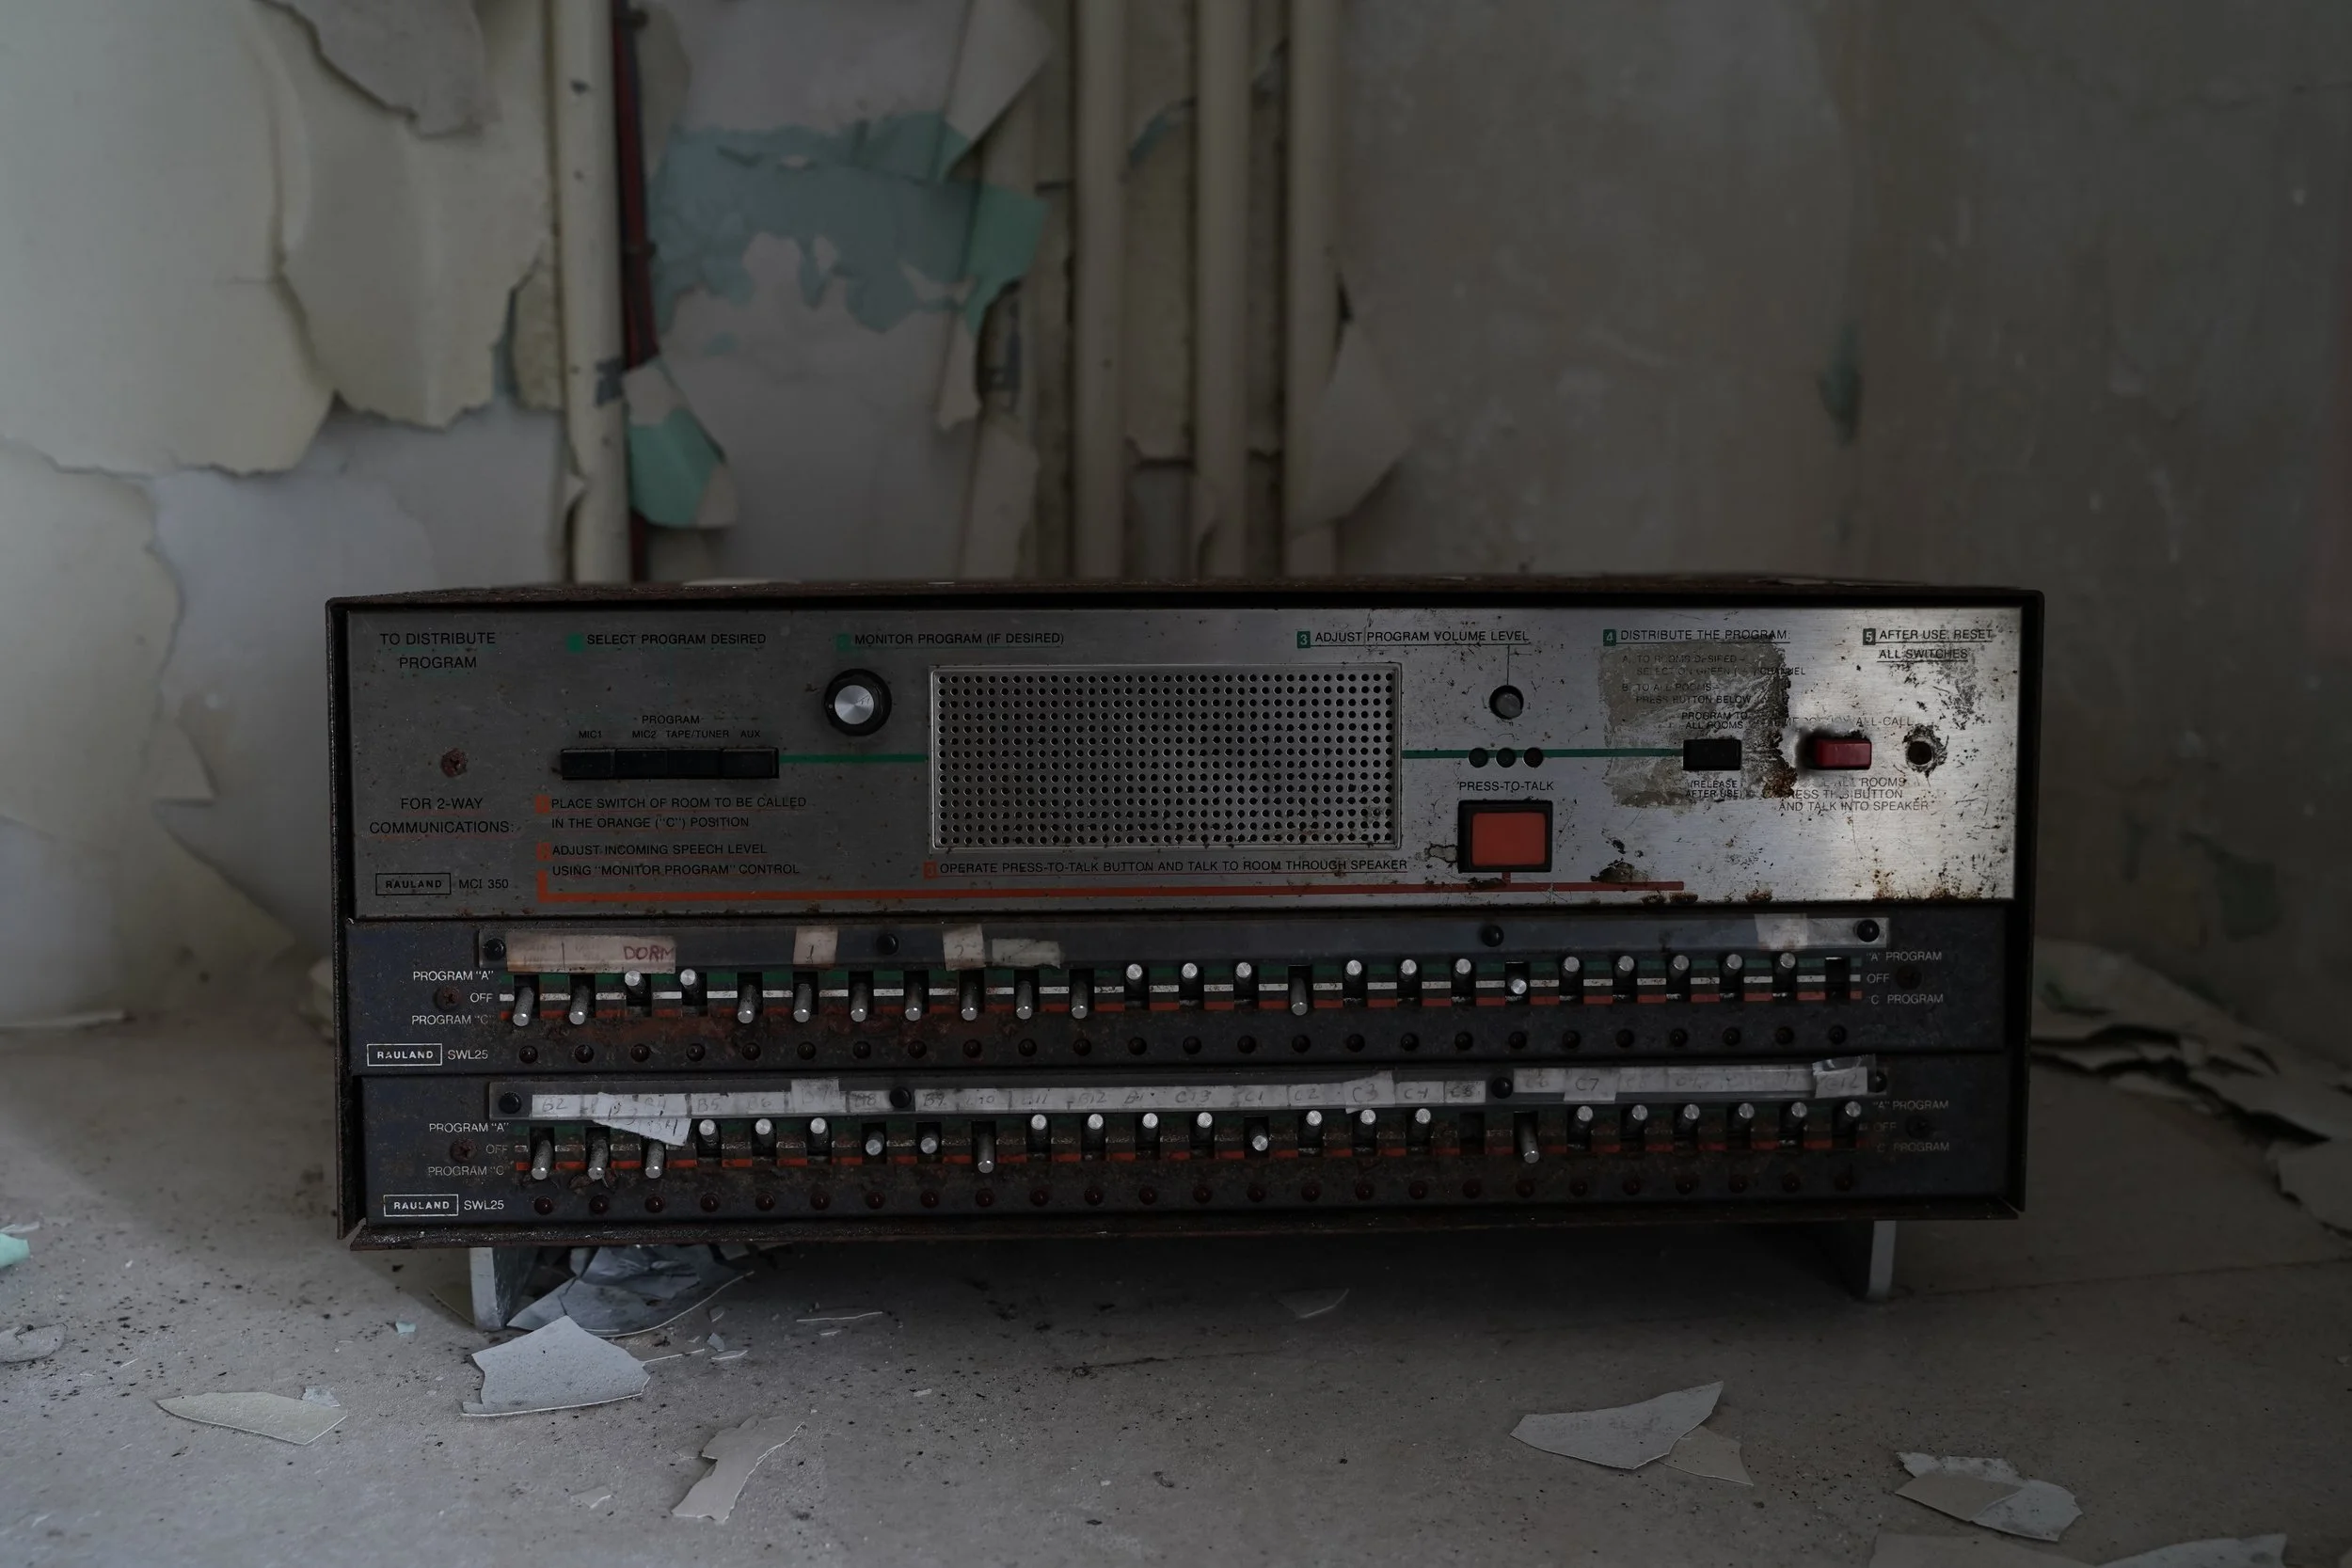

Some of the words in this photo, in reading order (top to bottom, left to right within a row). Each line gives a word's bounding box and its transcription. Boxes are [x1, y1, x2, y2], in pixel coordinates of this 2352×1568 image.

[380, 632, 400, 645] TO
[406, 631, 496, 645] DISTRIBUTE
[587, 634, 636, 645] SELECT
[642, 633, 706, 645] PROGRAM
[711, 633, 767, 644] DESIRED
[854, 633, 914, 645] MONITOR
[917, 633, 982, 644] PROGRAM
[986, 631, 1002, 646] (IF
[1006, 631, 1064, 645] DESIRED)
[1315, 631, 1362, 642] ADJUST
[1367, 631, 1430, 642] PROGRAM
[1434, 631, 1486, 641] VOLUME
[1491, 630, 1530, 641] LEVEL
[1620, 629, 1692, 641] DISTRIBUTE
[1697, 629, 1720, 641] THE
[1879, 629, 1918, 640] AFTER
[1953, 628, 1993, 640] RESET
[1879, 649, 1901, 659] ALL
[1905, 648, 1968, 658] SWITCHES
[399, 657, 477, 669] PROGRAM
[1716, 695, 1752, 705] BELOW
[642, 715, 700, 725] PROGRAM
[1681, 711, 1731, 721] PROGRAM
[1735, 711, 1748, 721] TO
[1685, 721, 1704, 730] ALL
[1707, 721, 1743, 730] ROOMS
[579, 730, 602, 739] MIC1
[632, 730, 657, 739] MIC2
[665, 730, 730, 739] TAPE/TUNER
[740, 730, 761, 738] AUX
[1459, 780, 1554, 792] PRESS-TO-TALK
[1861, 777, 1906, 787] ROOMS
[1685, 789, 1717, 799] AFTER
[1854, 788, 1902, 799] BUTTON
[401, 798, 432, 810] FOR
[437, 798, 484, 810] 2-WAY
[551, 798, 592, 809] PLACE
[596, 798, 645, 809] SWITCH
[650, 798, 667, 809] OF
[672, 797, 710, 808] ROOM
[715, 797, 732, 808] TO
[737, 797, 753, 808] BE
[756, 797, 806, 808] CALLED
[1779, 801, 1804, 812] AND
[1808, 801, 1836, 812] TALK
[1840, 801, 1869, 812] INTO
[1873, 801, 1929, 811] SPEAKER
[551, 817, 564, 829] IN
[568, 817, 592, 829] THE
[596, 817, 651, 829] ORANGE
[691, 816, 749, 828] POSITION
[552, 845, 602, 856] ADJUST
[605, 845, 668, 856] INCOMING
[673, 844, 723, 855] SPEECH
[728, 844, 767, 854] LEVEL
[552, 864, 591, 876] USING
[595, 864, 661, 876] "MONITOR
[664, 863, 736, 875] PROGRAM"
[739, 863, 800, 875] CONTROL
[940, 863, 998, 874] OPERATE
[1002, 862, 1099, 873] PRESS-TO-TALK
[1104, 861, 1153, 872] BUTTON
[1158, 861, 1184, 871] AND
[1187, 861, 1217, 871] TALK
[1222, 861, 1239, 871] TO
[1243, 860, 1280, 871] ROOM
[1286, 860, 1346, 871] THROUGH
[1350, 860, 1407, 870] SPEAKER
[385, 879, 443, 889] RAULAND
[458, 879, 483, 890] MCI
[487, 879, 509, 889] 350
[623, 944, 675, 960] DORM
[1885, 951, 1942, 961] PROGRAM
[413, 970, 471, 981] PROGRAM
[475, 970, 495, 980] "A"
[1866, 974, 1889, 984] OFF
[469, 992, 493, 1004] OFF
[1887, 994, 1944, 1005] PROGRAM
[411, 1014, 471, 1026] PROGRAM
[376, 1050, 434, 1060] RAULAND
[447, 1049, 488, 1060] SWL25
[1892, 1100, 1948, 1111] PROGRAM
[429, 1122, 488, 1133] PROGRAM
[491, 1122, 510, 1132] "A"
[1873, 1121, 1897, 1132] OFF
[485, 1144, 509, 1154] OFF
[1893, 1142, 1949, 1152] PROGRAM
[427, 1165, 488, 1177] PROGRAM
[393, 1201, 450, 1211] RAULAND
[463, 1199, 504, 1212] SWL25
